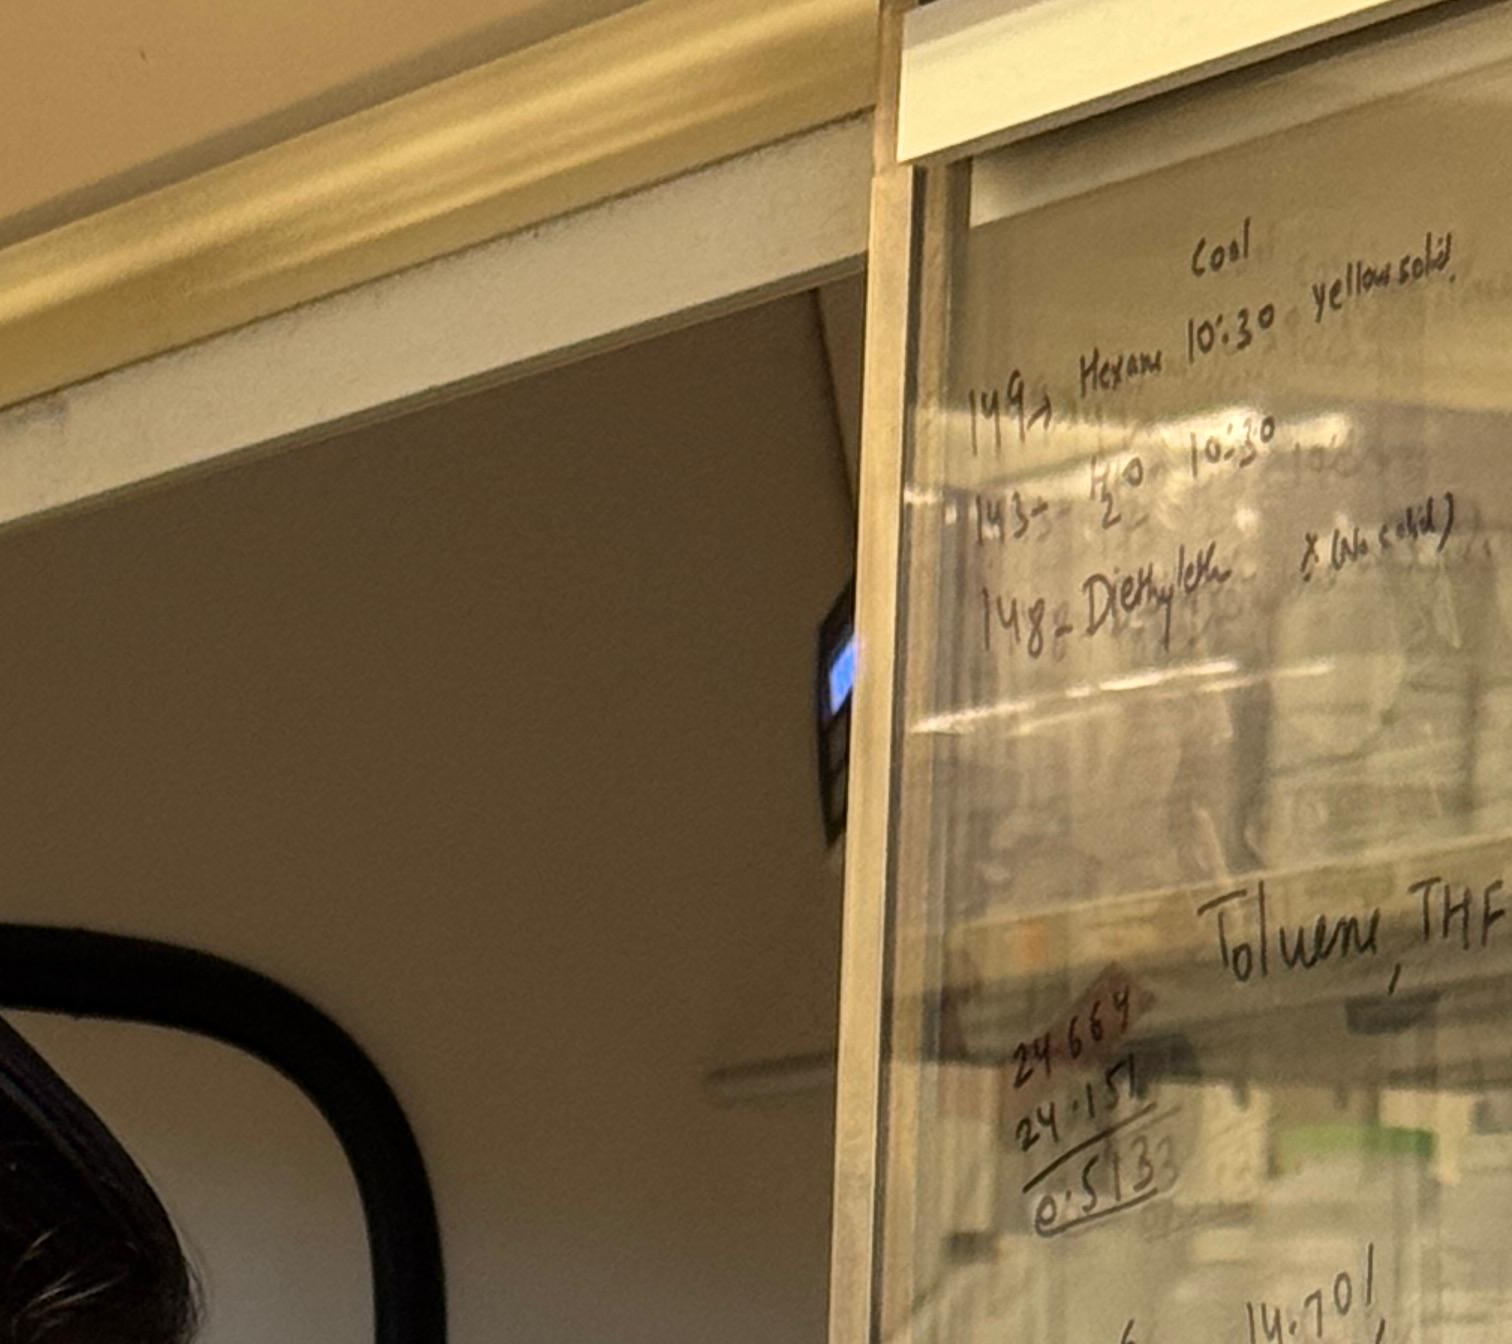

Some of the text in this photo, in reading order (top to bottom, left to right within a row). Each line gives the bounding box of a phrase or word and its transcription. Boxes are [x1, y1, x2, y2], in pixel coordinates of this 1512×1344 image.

[1188, 303, 1276, 364] 10:30
[1189, 414, 1276, 480] 10:30
[1407, 876, 1506, 951] THF
